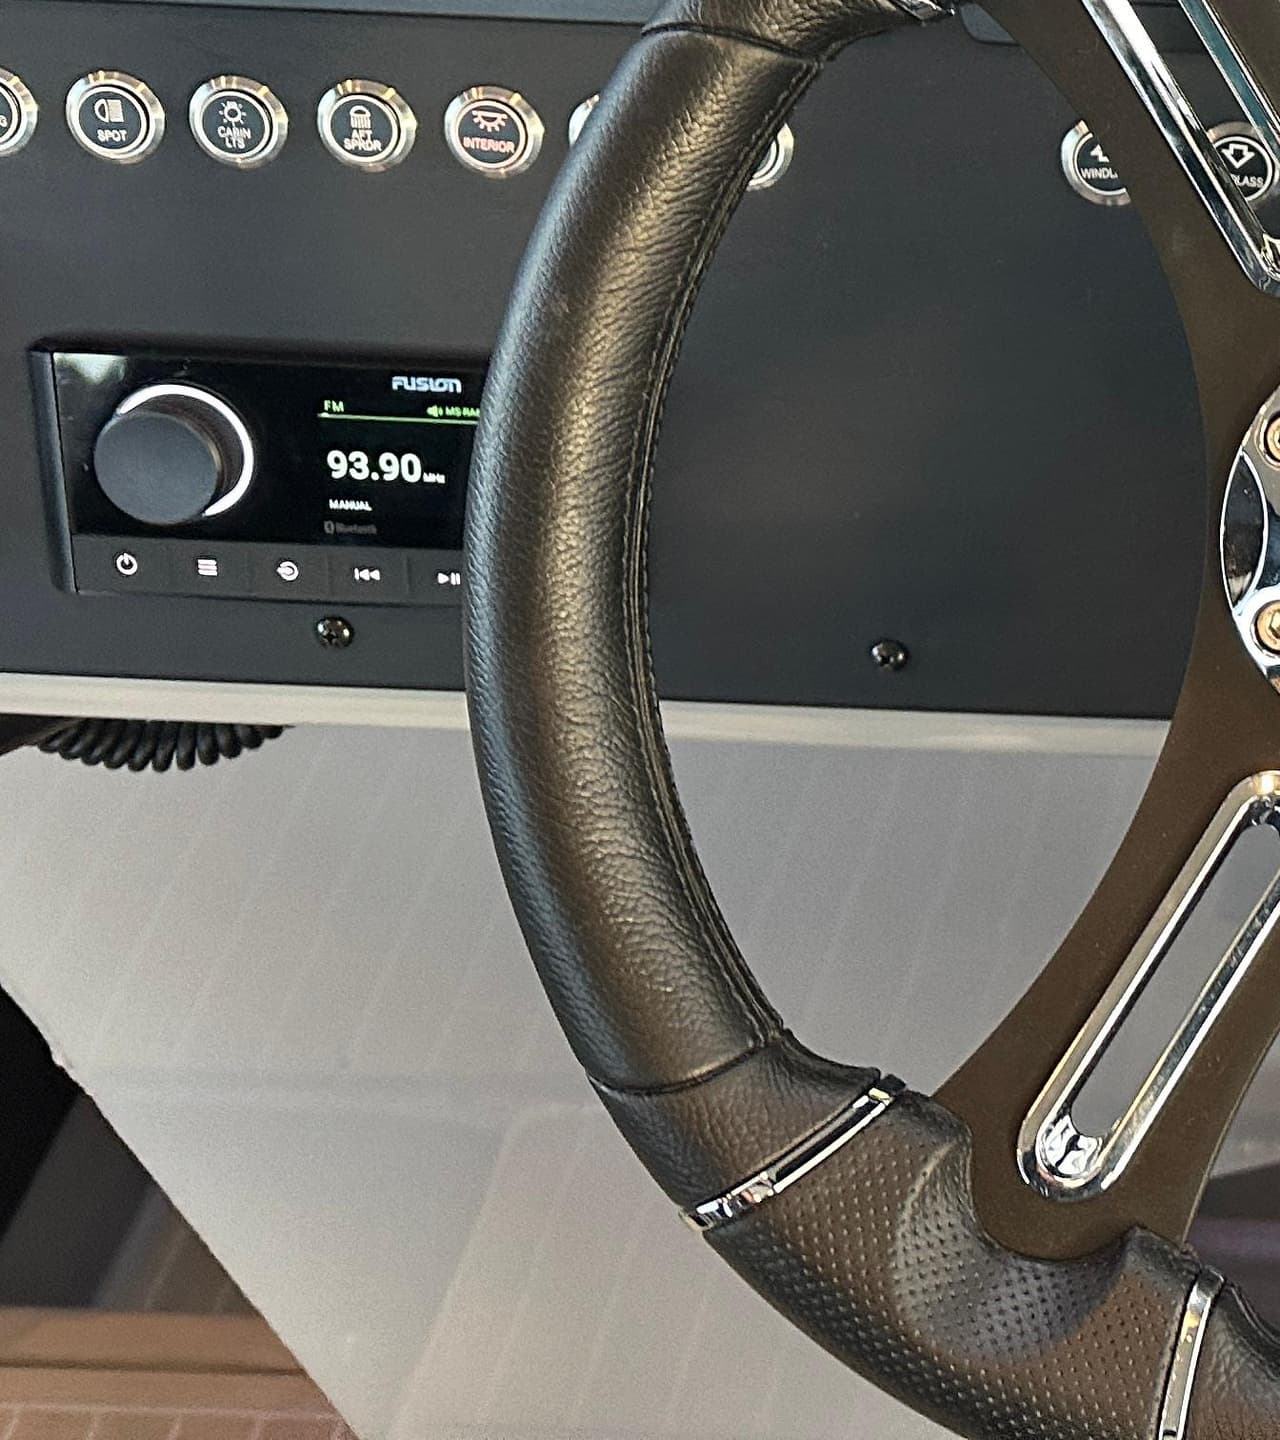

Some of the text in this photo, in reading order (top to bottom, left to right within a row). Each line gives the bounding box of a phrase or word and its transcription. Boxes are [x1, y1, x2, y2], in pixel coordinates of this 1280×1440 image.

[97, 129, 127, 143] SPOT
[463, 136, 516, 154] INTERIOR
[324, 399, 345, 412] FM
[326, 449, 422, 483] 93.90
[329, 498, 373, 511] MANUAL
